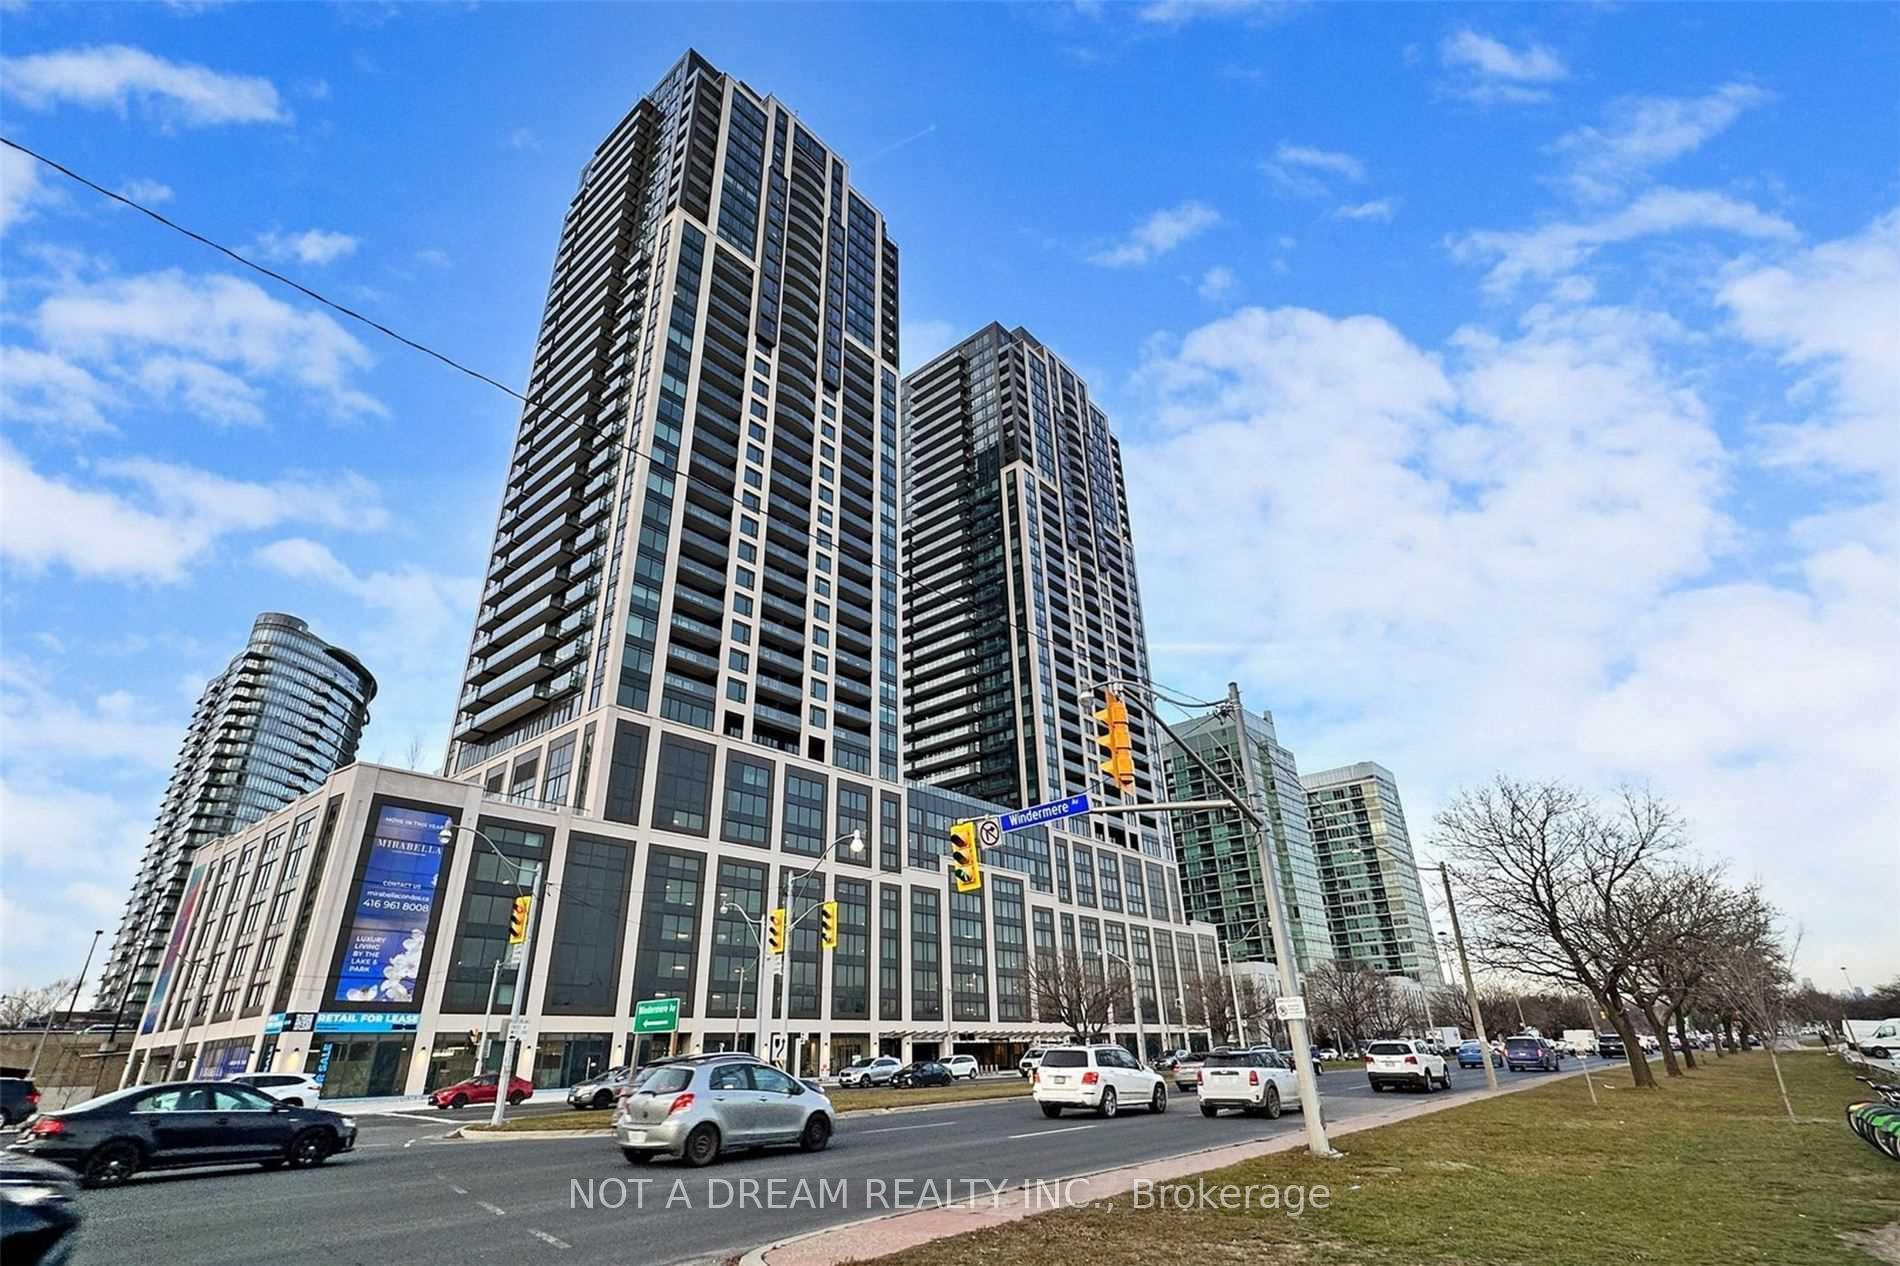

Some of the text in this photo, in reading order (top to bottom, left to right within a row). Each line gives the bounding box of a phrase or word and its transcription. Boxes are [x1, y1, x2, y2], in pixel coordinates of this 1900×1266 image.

[1009, 803, 1069, 826] Windermere
[376, 839, 442, 855] MIRABELLA
[383, 880, 412, 889] CONTACT
[363, 899, 429, 912] 416 961 8008
[318, 1013, 418, 1023] RETAIL FOR LEASE
[318, 1043, 333, 1072] SALE
